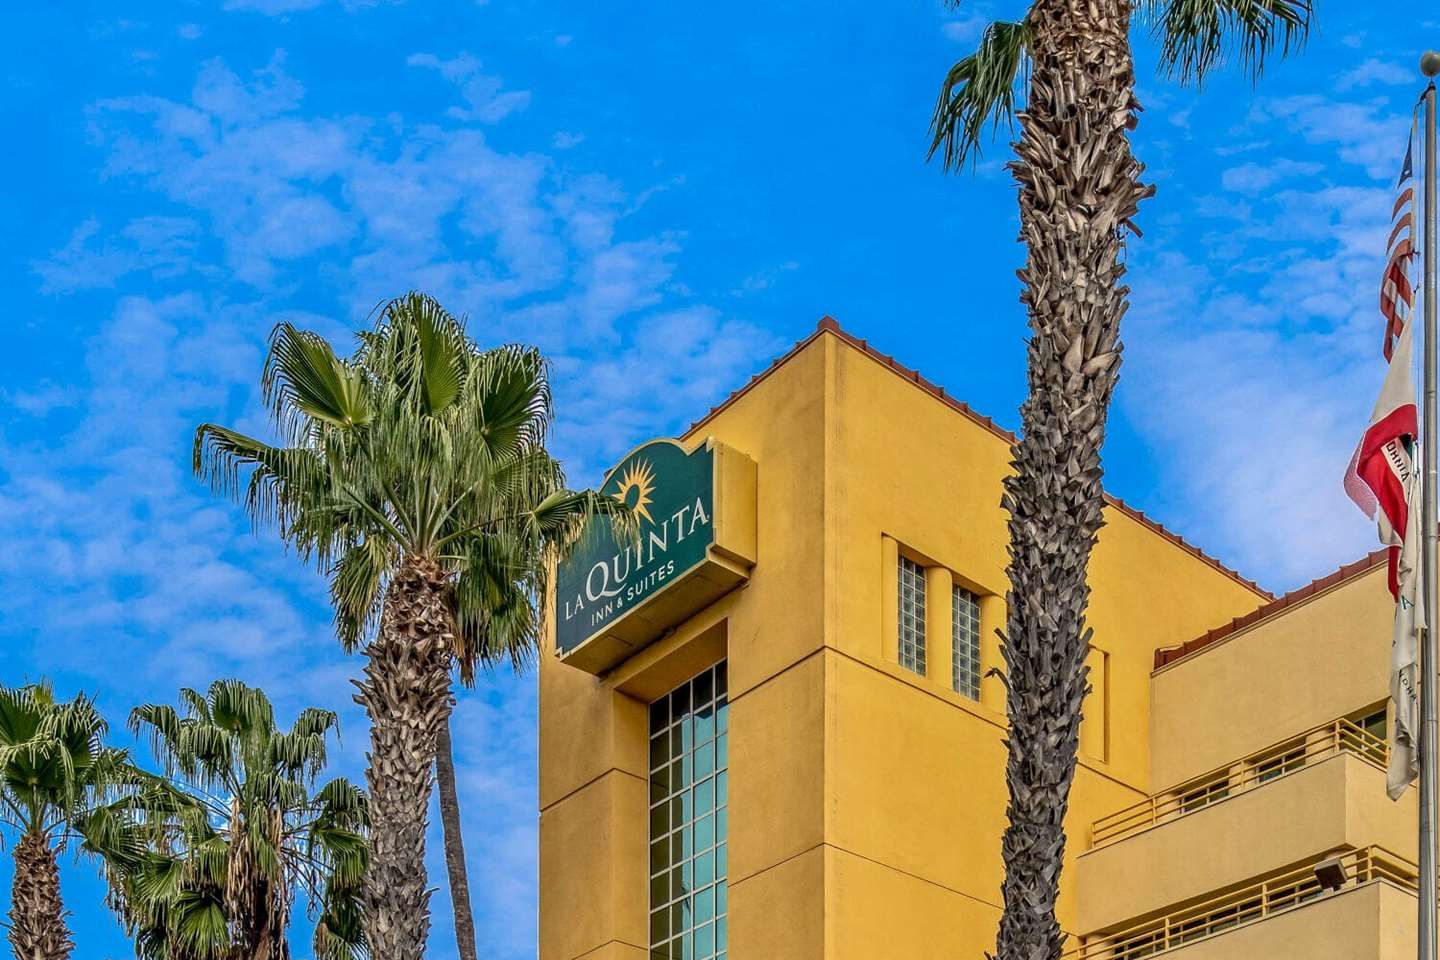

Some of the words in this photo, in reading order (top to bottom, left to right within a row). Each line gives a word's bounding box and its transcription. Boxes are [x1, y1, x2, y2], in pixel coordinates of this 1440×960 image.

[565, 592, 585, 620] LA
[585, 497, 709, 601] QUINTA
[591, 601, 614, 626] INN
[616, 597, 623, 608] &
[627, 560, 674, 601] SUITES
